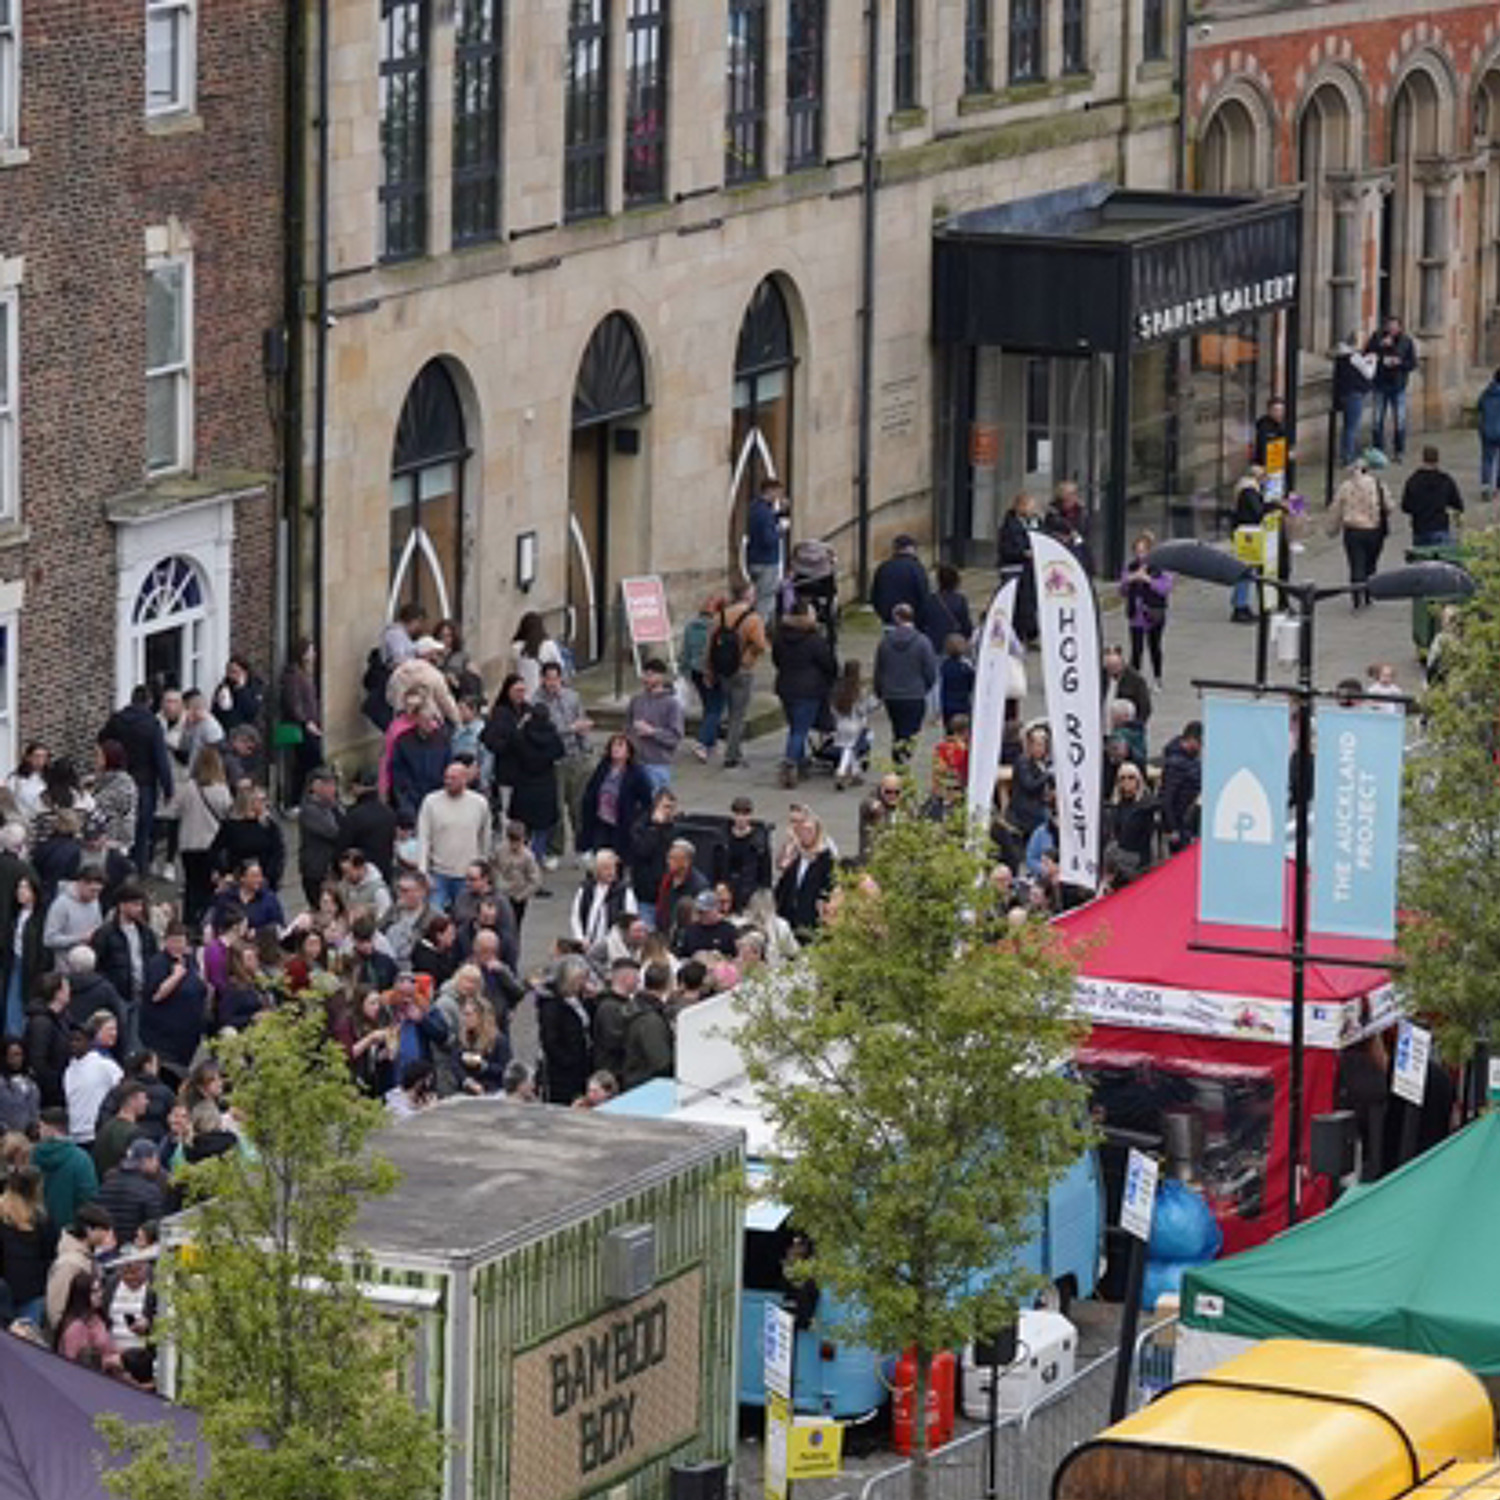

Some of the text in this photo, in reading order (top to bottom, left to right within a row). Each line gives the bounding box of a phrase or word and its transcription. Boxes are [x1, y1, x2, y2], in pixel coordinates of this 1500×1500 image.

[1335, 731, 1358, 855] AUCKLAND
[1356, 770, 1377, 872] PROJECT
[550, 1298, 668, 1417] BAMBOO
[580, 1388, 635, 1475] BOX
